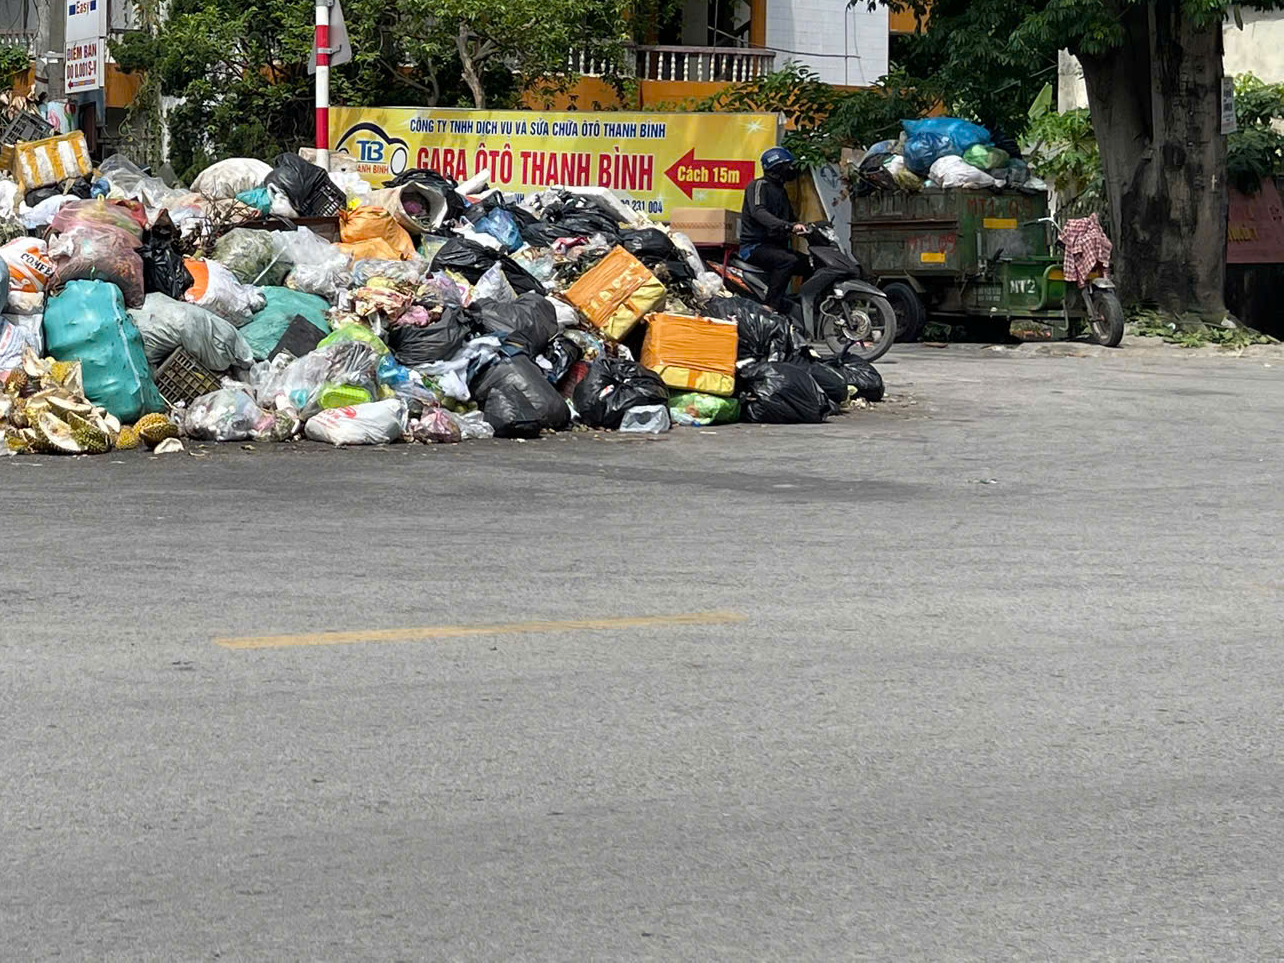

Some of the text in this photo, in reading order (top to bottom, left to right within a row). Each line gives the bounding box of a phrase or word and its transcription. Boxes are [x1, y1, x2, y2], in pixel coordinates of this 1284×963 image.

[76, 0, 90, 16] Easy
[410, 117, 666, 138] CÔNG TY TNHH DỊCH VỤ VÀ SỬA CHỮA ÔTÔ THANH BÌNH
[417, 142, 654, 191] GARA ÔTÔ THANH BÌNH
[677, 165, 741, 184] Cách 15m
[648, 200, 663, 214] 004
[20, 252, 53, 276] COMFE
[1009, 279, 1037, 294] MT2
